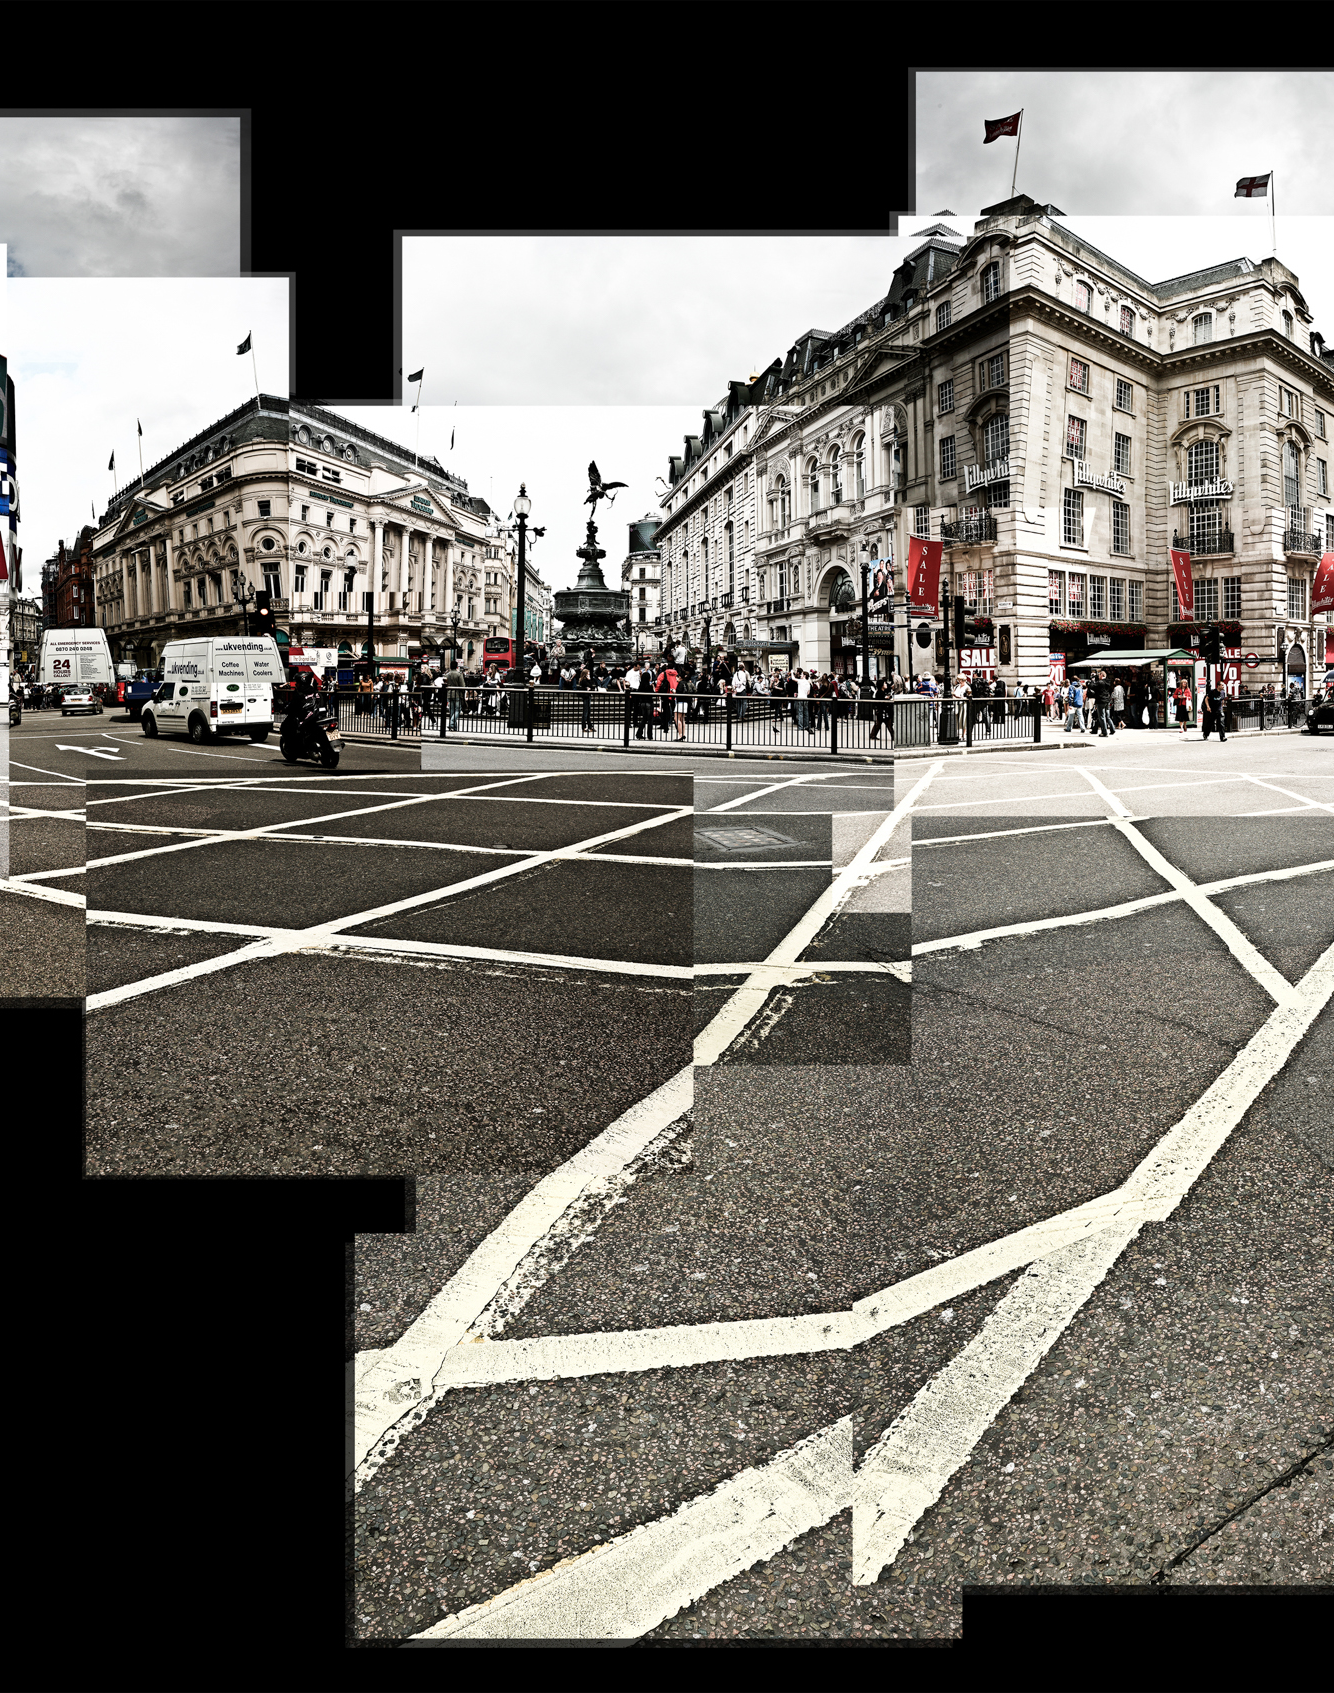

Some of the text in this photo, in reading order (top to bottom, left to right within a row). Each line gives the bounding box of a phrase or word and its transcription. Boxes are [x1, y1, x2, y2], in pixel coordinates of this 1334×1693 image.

[1074, 456, 1127, 495] Lillywhites
[1169, 476, 1235, 506] Lillywhites
[918, 546, 928, 596] SALE
[1180, 557, 1190, 602] SALE
[53, 659, 70, 669] 24
[1220, 649, 1240, 658] ALE
